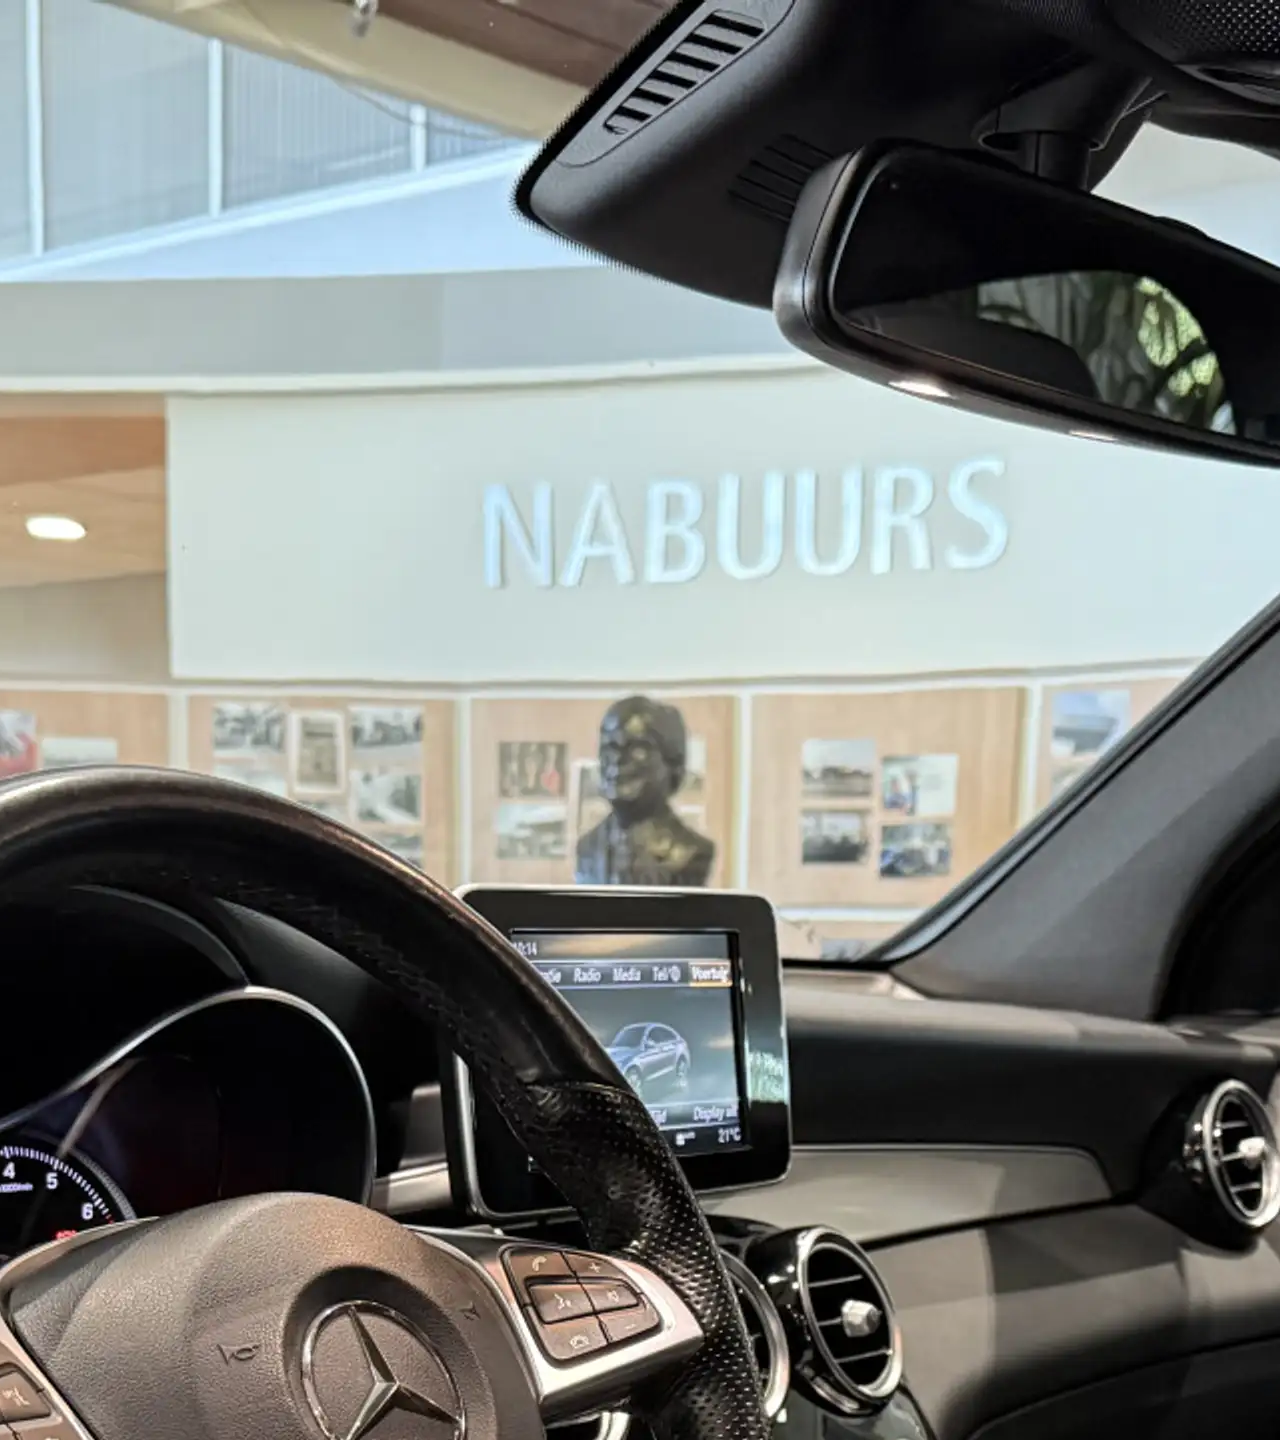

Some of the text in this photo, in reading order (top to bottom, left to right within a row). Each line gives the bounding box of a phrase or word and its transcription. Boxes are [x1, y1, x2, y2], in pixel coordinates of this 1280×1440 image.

[481, 453, 1010, 589] NABUURS
[573, 967, 602, 983] Radio
[613, 966, 642, 982] Media
[693, 1105, 725, 1124] Display
[2, 1161, 16, 1179] 4
[45, 1172, 59, 1190] 5
[81, 1202, 94, 1220] 6
